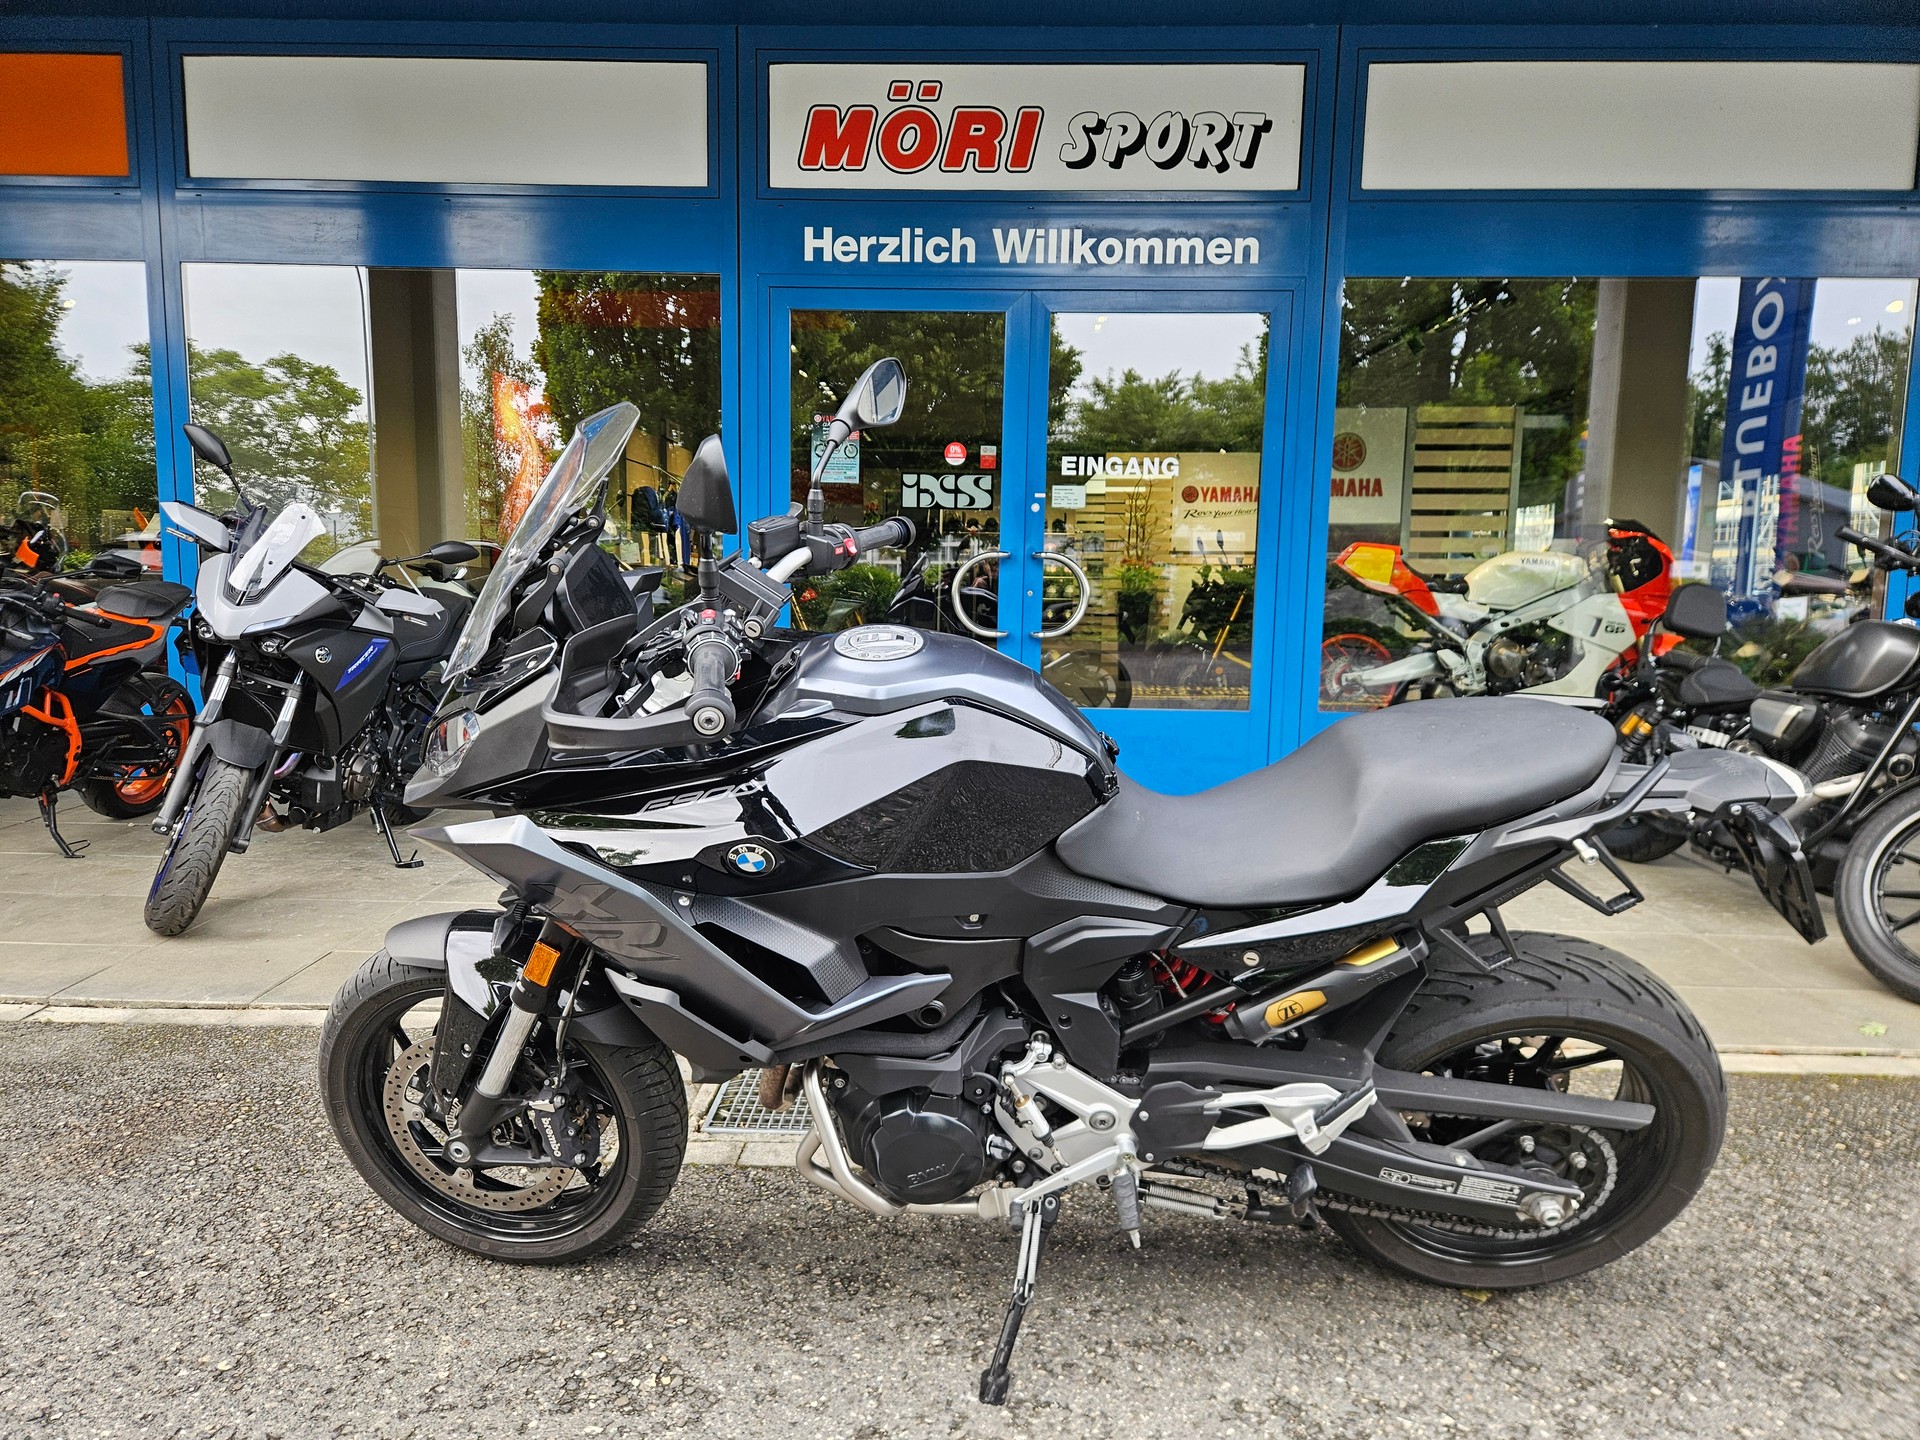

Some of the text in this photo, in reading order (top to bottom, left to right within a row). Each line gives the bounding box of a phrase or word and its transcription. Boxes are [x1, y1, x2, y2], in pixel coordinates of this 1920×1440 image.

[798, 80, 1273, 174] MÖRI SPORT
[804, 226, 1260, 264] Herzlich Willkommen
[949, 445, 962, 454] 0%
[1061, 455, 1180, 477] EINGANG
[1520, 556, 1556, 568] YAMAHA
[728, 846, 765, 861] BMW
[541, 1117, 562, 1157] brembo
[907, 1163, 947, 1185] BMW
